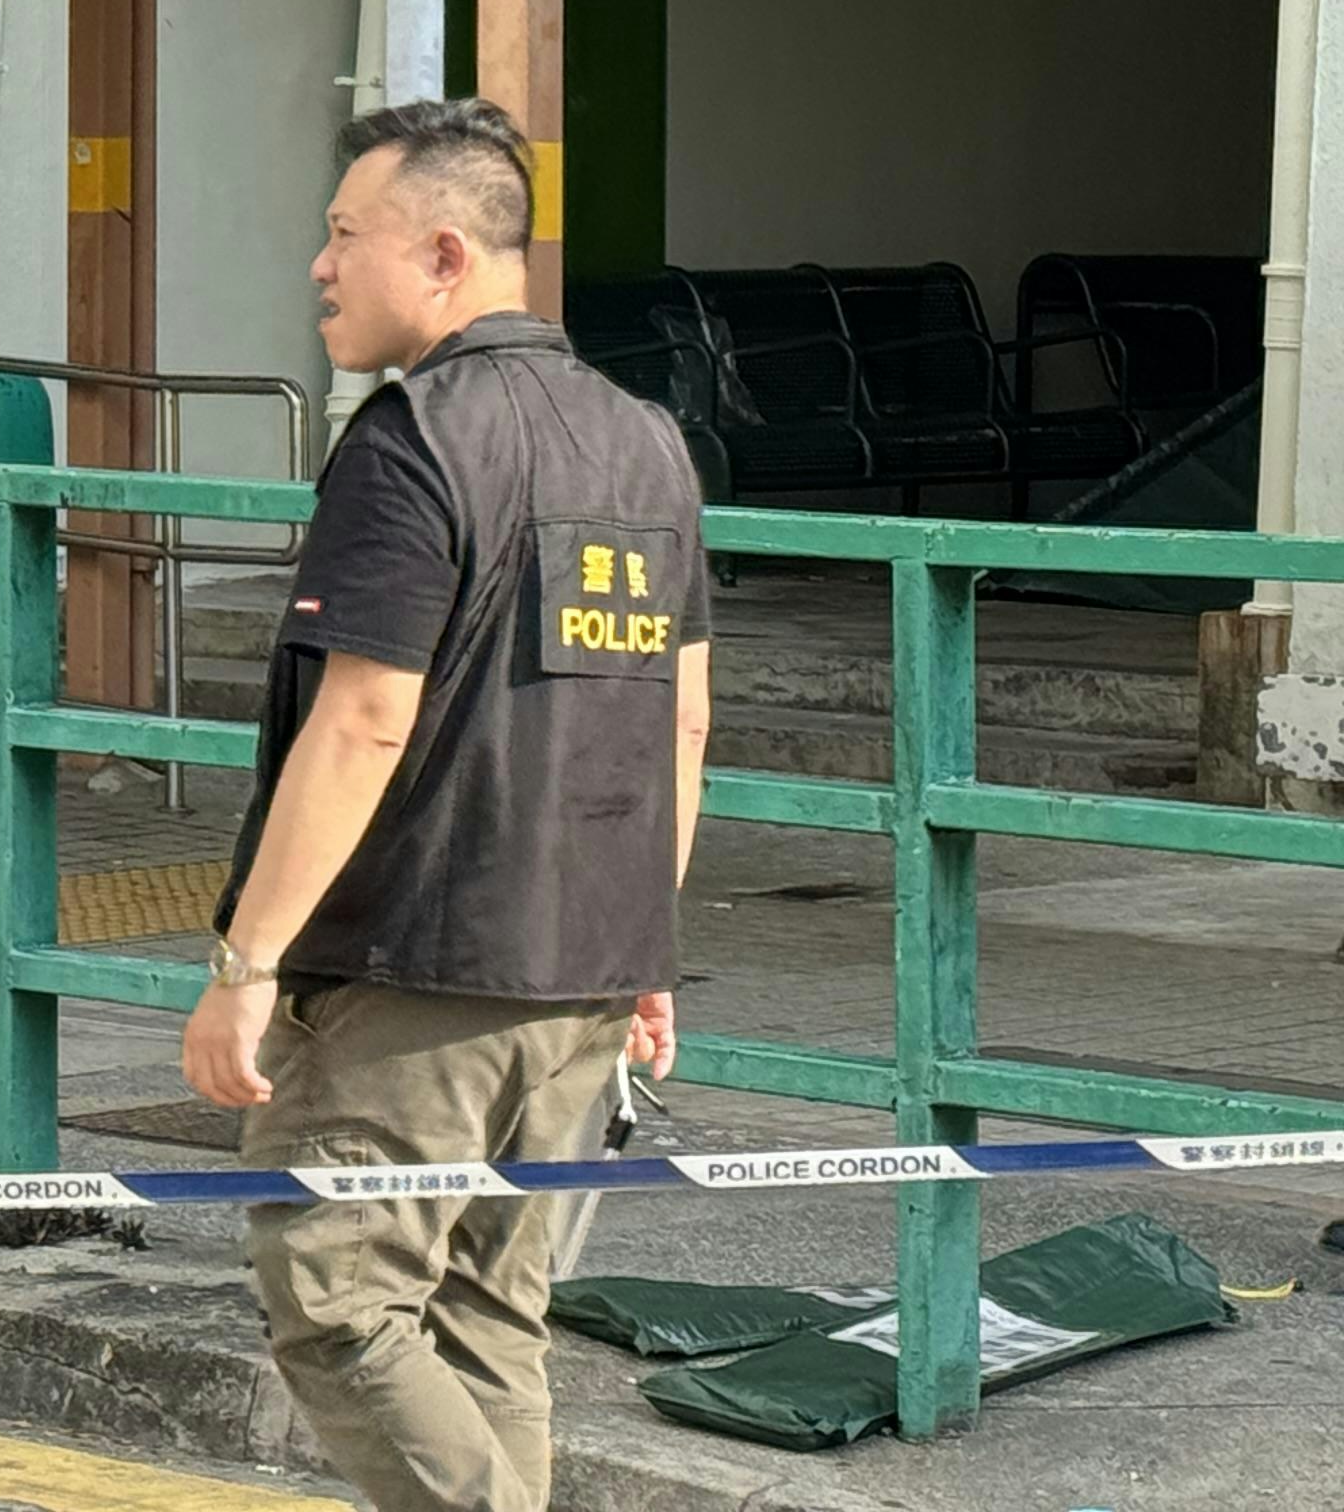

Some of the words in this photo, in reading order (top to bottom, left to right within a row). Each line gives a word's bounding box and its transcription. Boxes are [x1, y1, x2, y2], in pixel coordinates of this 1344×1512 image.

[561, 608, 671, 654] POLICE
[708, 1159, 811, 1182] POLICE
[817, 1154, 941, 1178] CORDON
